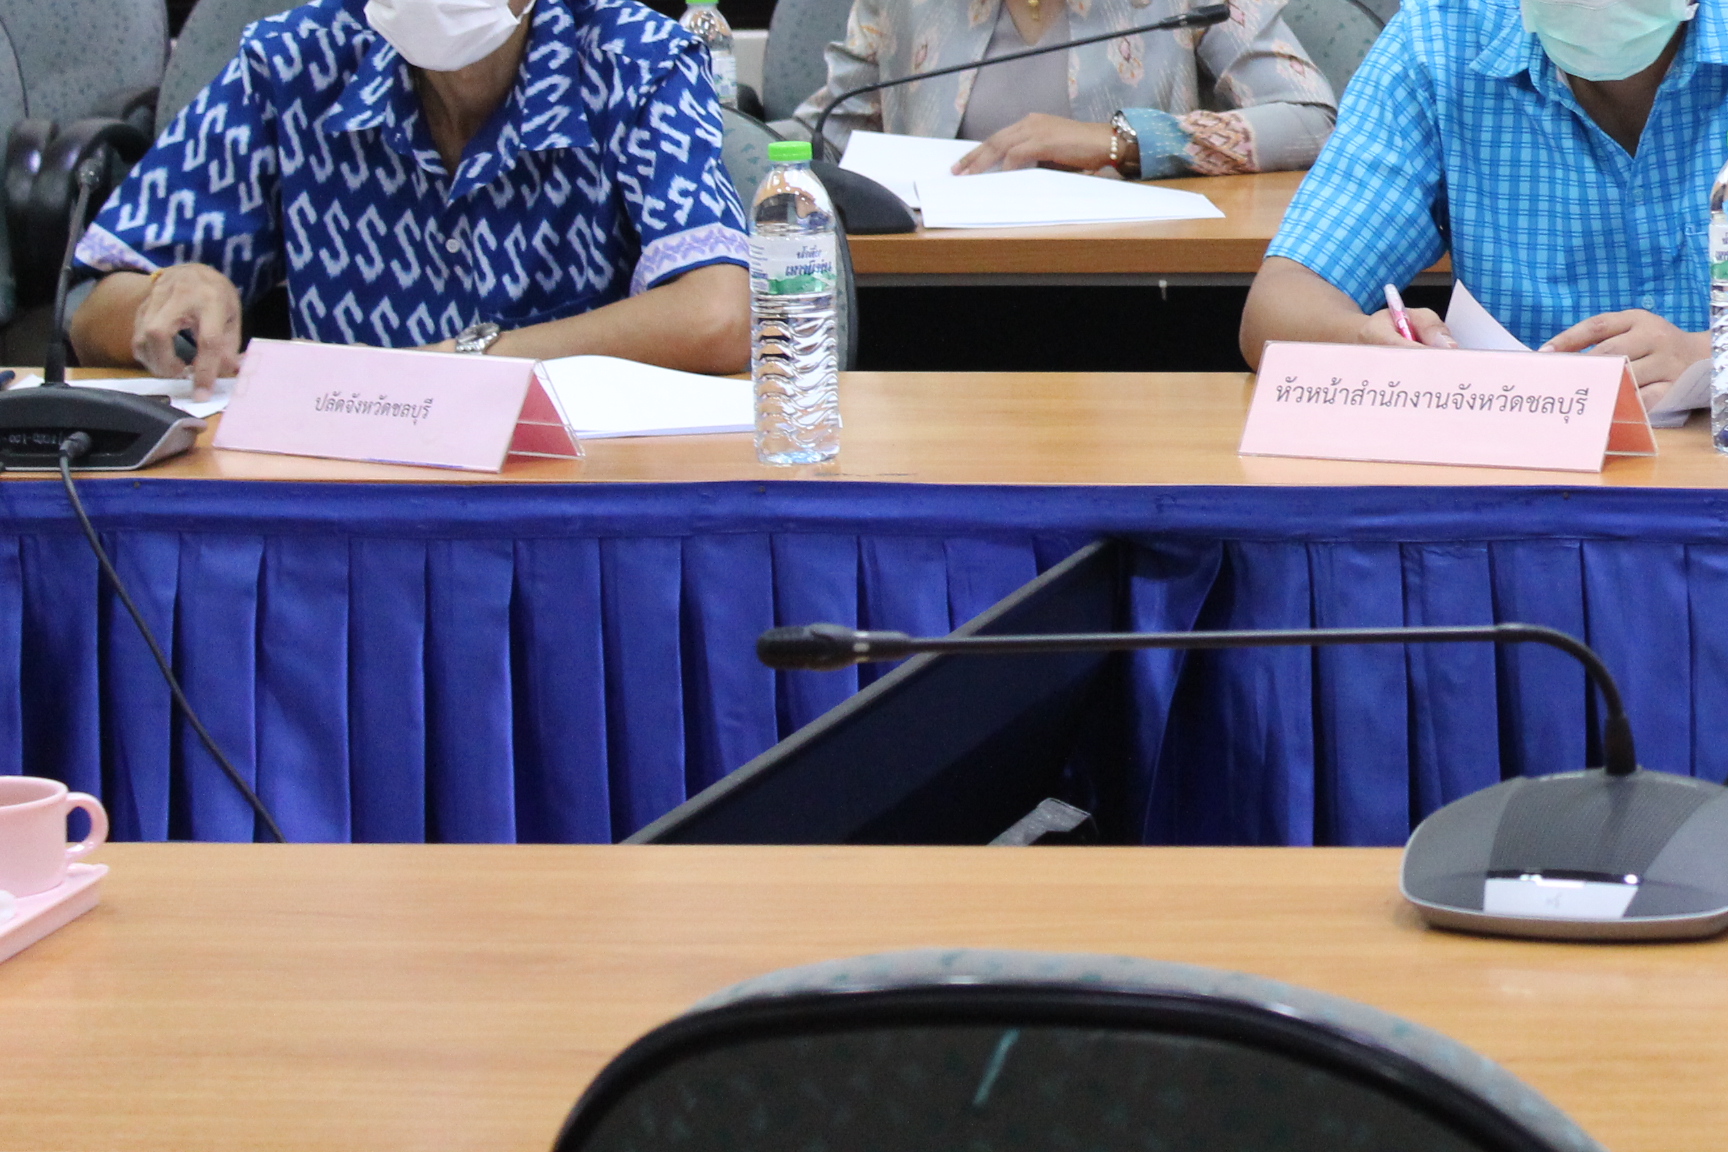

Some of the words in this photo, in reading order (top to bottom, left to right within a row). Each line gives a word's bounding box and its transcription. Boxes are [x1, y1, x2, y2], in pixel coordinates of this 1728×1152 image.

[314, 391, 434, 426] ปลัดจังหวัดชลบุรี
[1275, 375, 1590, 426] หัวหน้าสำนักงานจังหวัดชลบุรี
